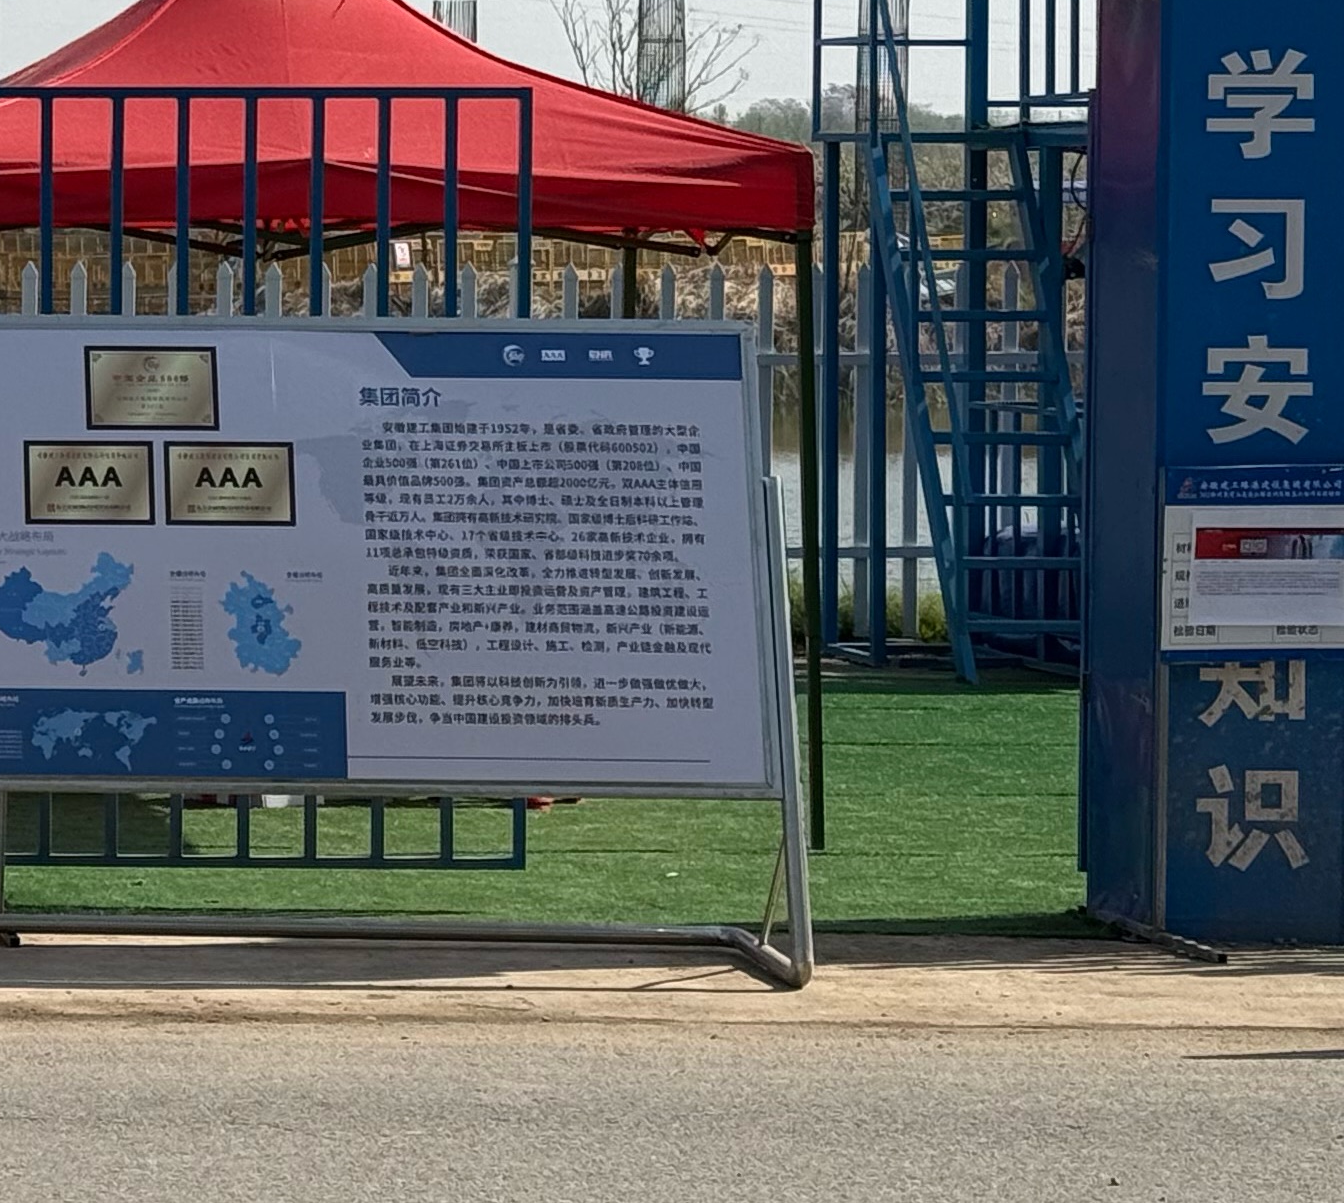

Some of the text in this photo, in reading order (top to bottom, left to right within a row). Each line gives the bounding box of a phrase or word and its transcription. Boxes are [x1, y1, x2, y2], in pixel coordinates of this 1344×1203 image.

[358, 387, 441, 407] 集团简介
[54, 466, 123, 488] AAA
[194, 467, 264, 489] AAA
